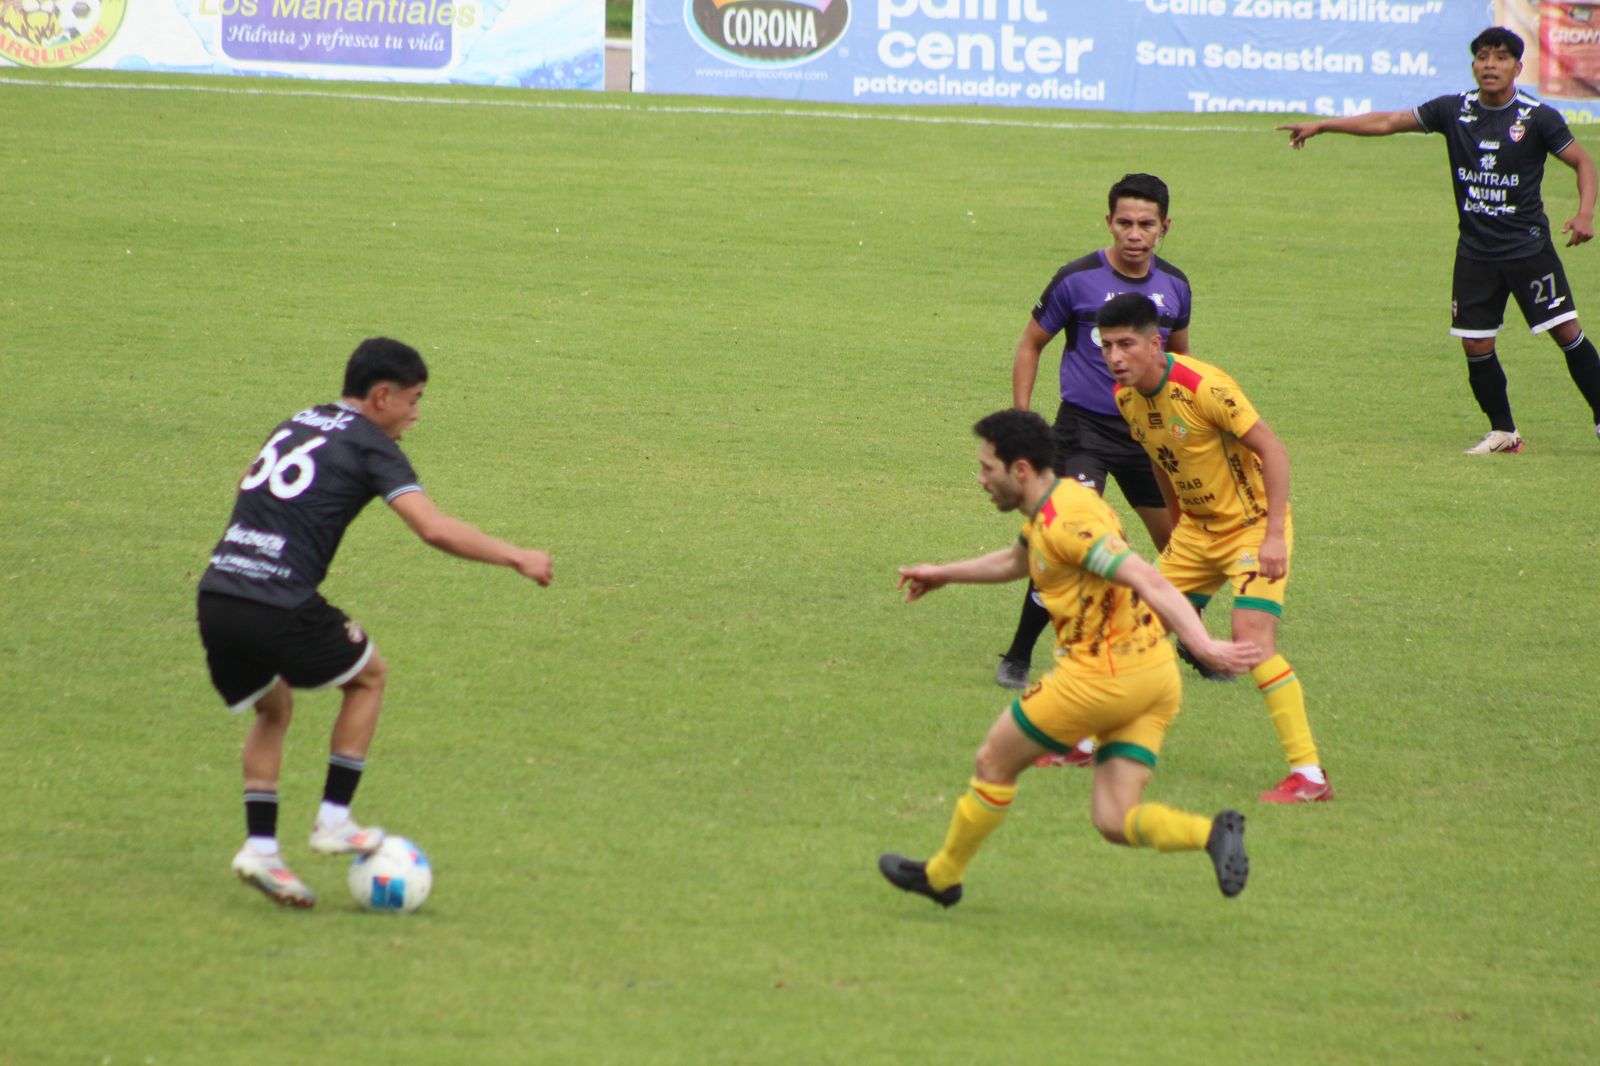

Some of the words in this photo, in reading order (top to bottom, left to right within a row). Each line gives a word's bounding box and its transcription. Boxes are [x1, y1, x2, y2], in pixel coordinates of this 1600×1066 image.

[1232, 0, 1314, 20] Zona
[227, 24, 295, 44] Hidrata
[299, 31, 312, 50] y
[316, 28, 380, 52] refresca
[384, 33, 403, 49] tu
[408, 32, 444, 51] vida
[722, 8, 819, 48] CORONA
[877, 24, 1095, 74] center
[1136, 41, 1197, 66] San
[1204, 44, 1364, 73] Sebastian
[1371, 50, 1437, 76] S.M.
[853, 75, 1023, 99] patrocinador
[1026, 79, 1106, 101] oficial
[1457, 166, 1520, 187] BANTRAB
[1468, 185, 1507, 202] MUNI
[1529, 272, 1557, 304] 27
